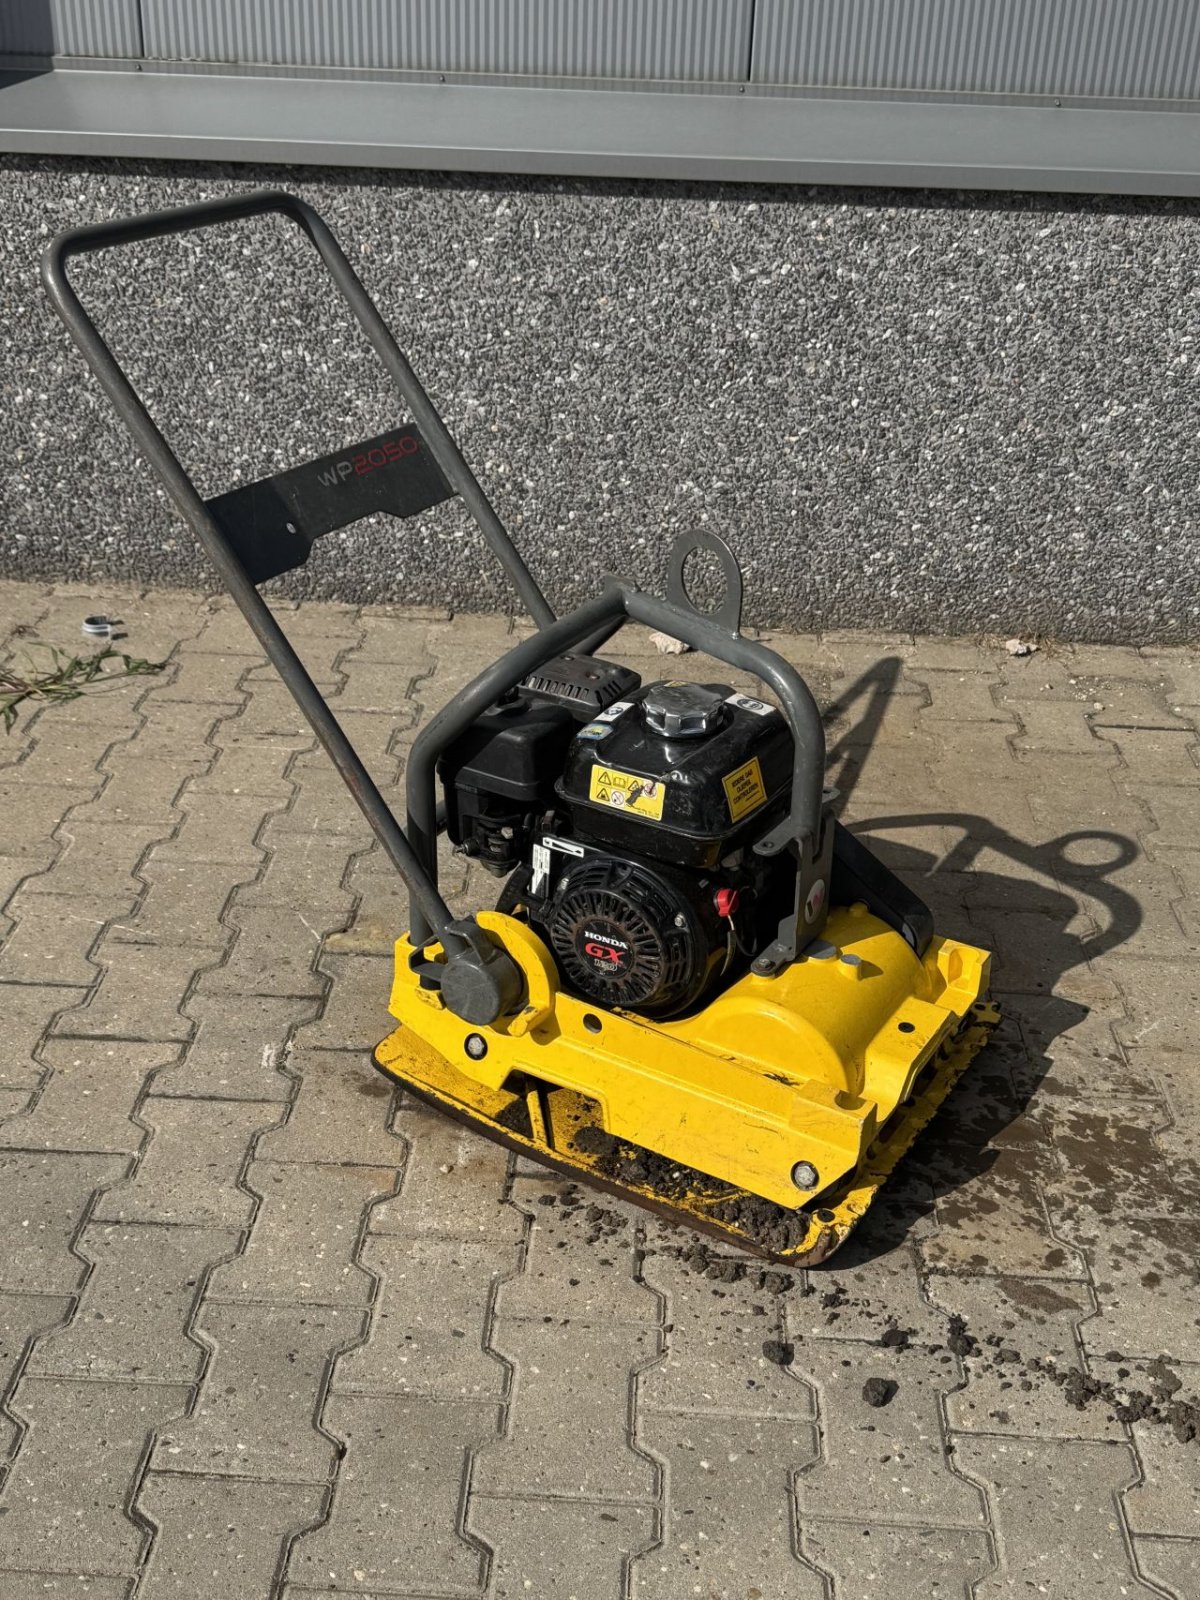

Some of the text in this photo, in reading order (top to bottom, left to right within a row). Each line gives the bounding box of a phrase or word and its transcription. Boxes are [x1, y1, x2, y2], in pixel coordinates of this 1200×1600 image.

[318, 436, 418, 487] WP2050
[584, 930, 628, 950] HONDA
[585, 942, 625, 964] GX
